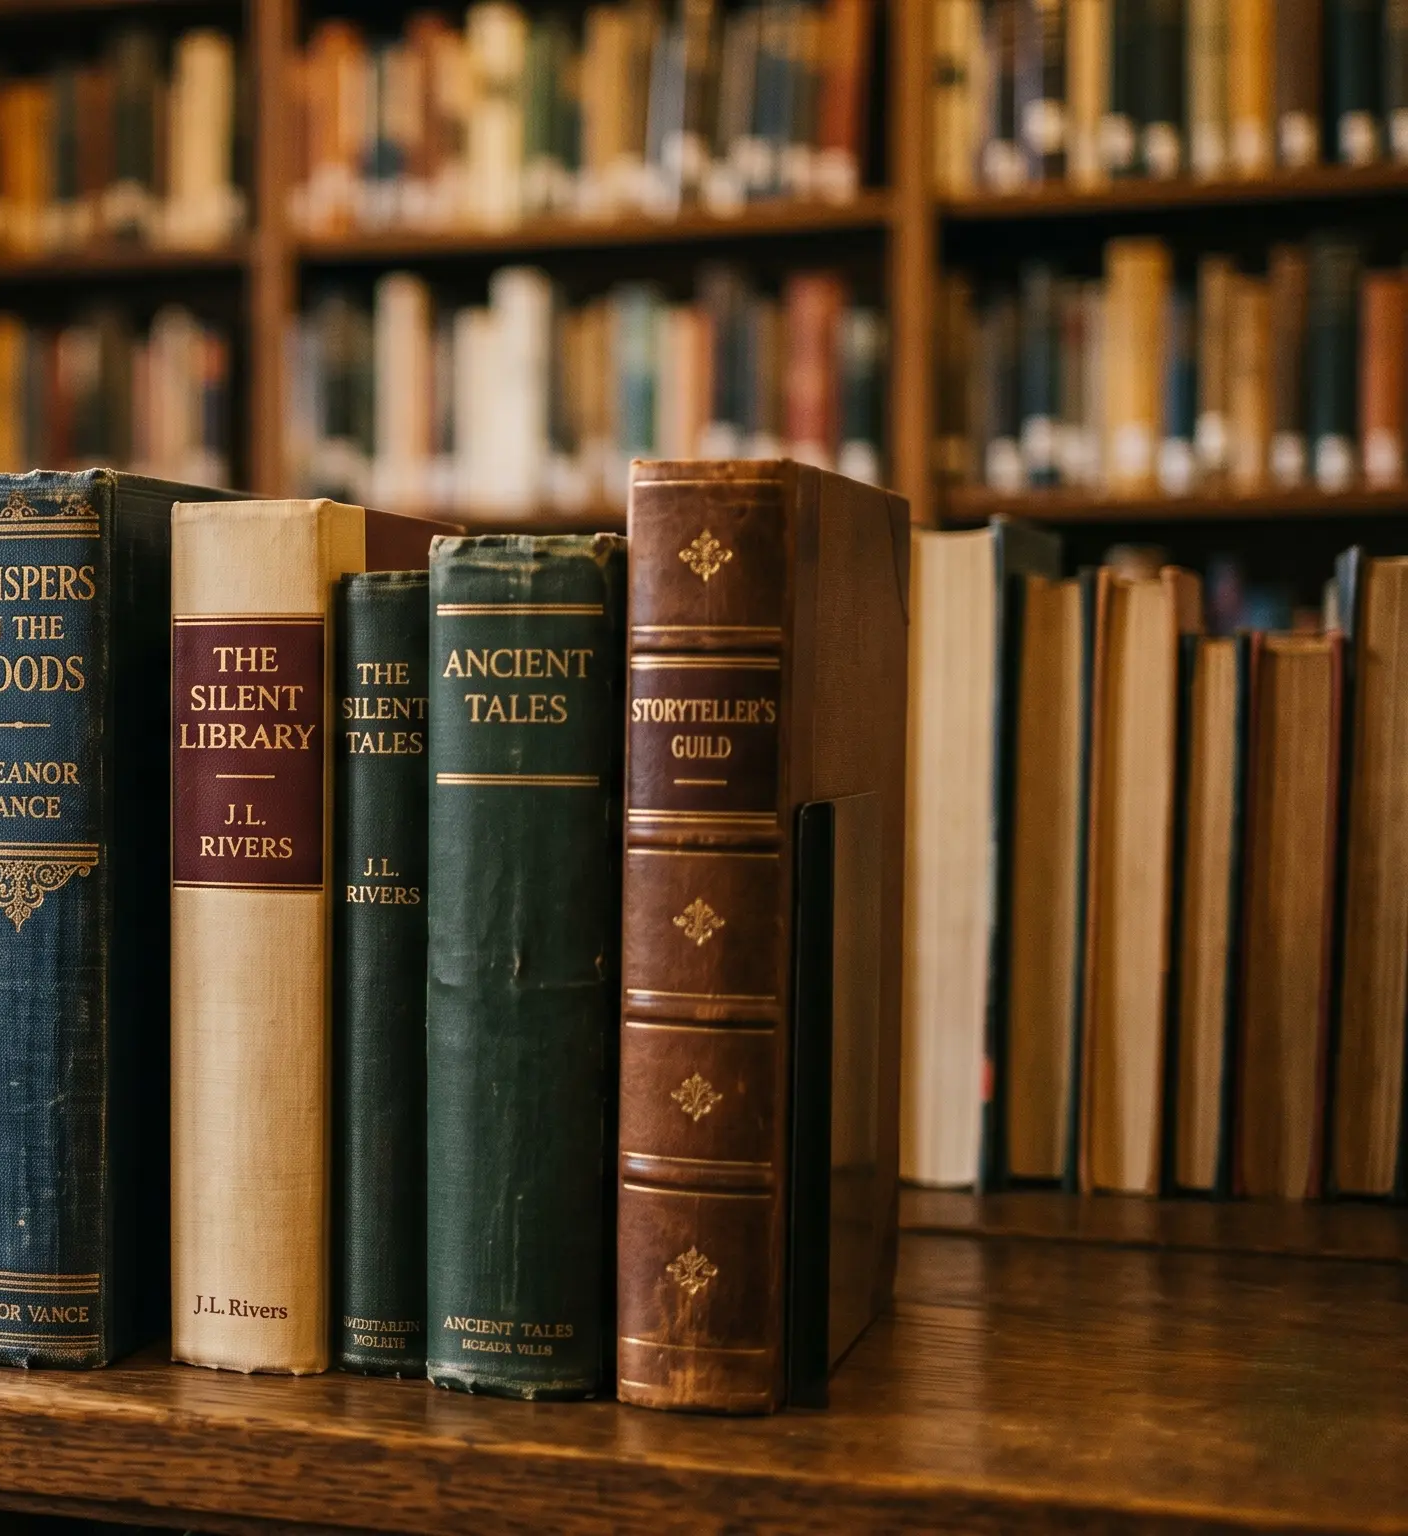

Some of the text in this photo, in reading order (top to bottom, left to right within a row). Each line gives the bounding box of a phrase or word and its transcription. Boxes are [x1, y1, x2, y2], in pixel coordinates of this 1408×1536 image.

[12, 615, 65, 640] THE
[213, 646, 279, 673] THE
[442, 648, 594, 679] ANCIENT
[356, 662, 410, 686] THE
[190, 684, 304, 712] SILENT
[342, 697, 429, 721] SILENT
[465, 694, 569, 724] TALES
[631, 696, 777, 723] STORYTELLER'S
[179, 723, 316, 750] LIBRARY
[345, 731, 424, 755] TALES
[671, 735, 732, 760] GUILD
[200, 836, 293, 859] RIVERS
[346, 885, 421, 905] RIVERS
[27, 1305, 90, 1323] VANCE
[228, 1298, 288, 1320] Rivers
[443, 1315, 575, 1338] ANCIENT TALES
